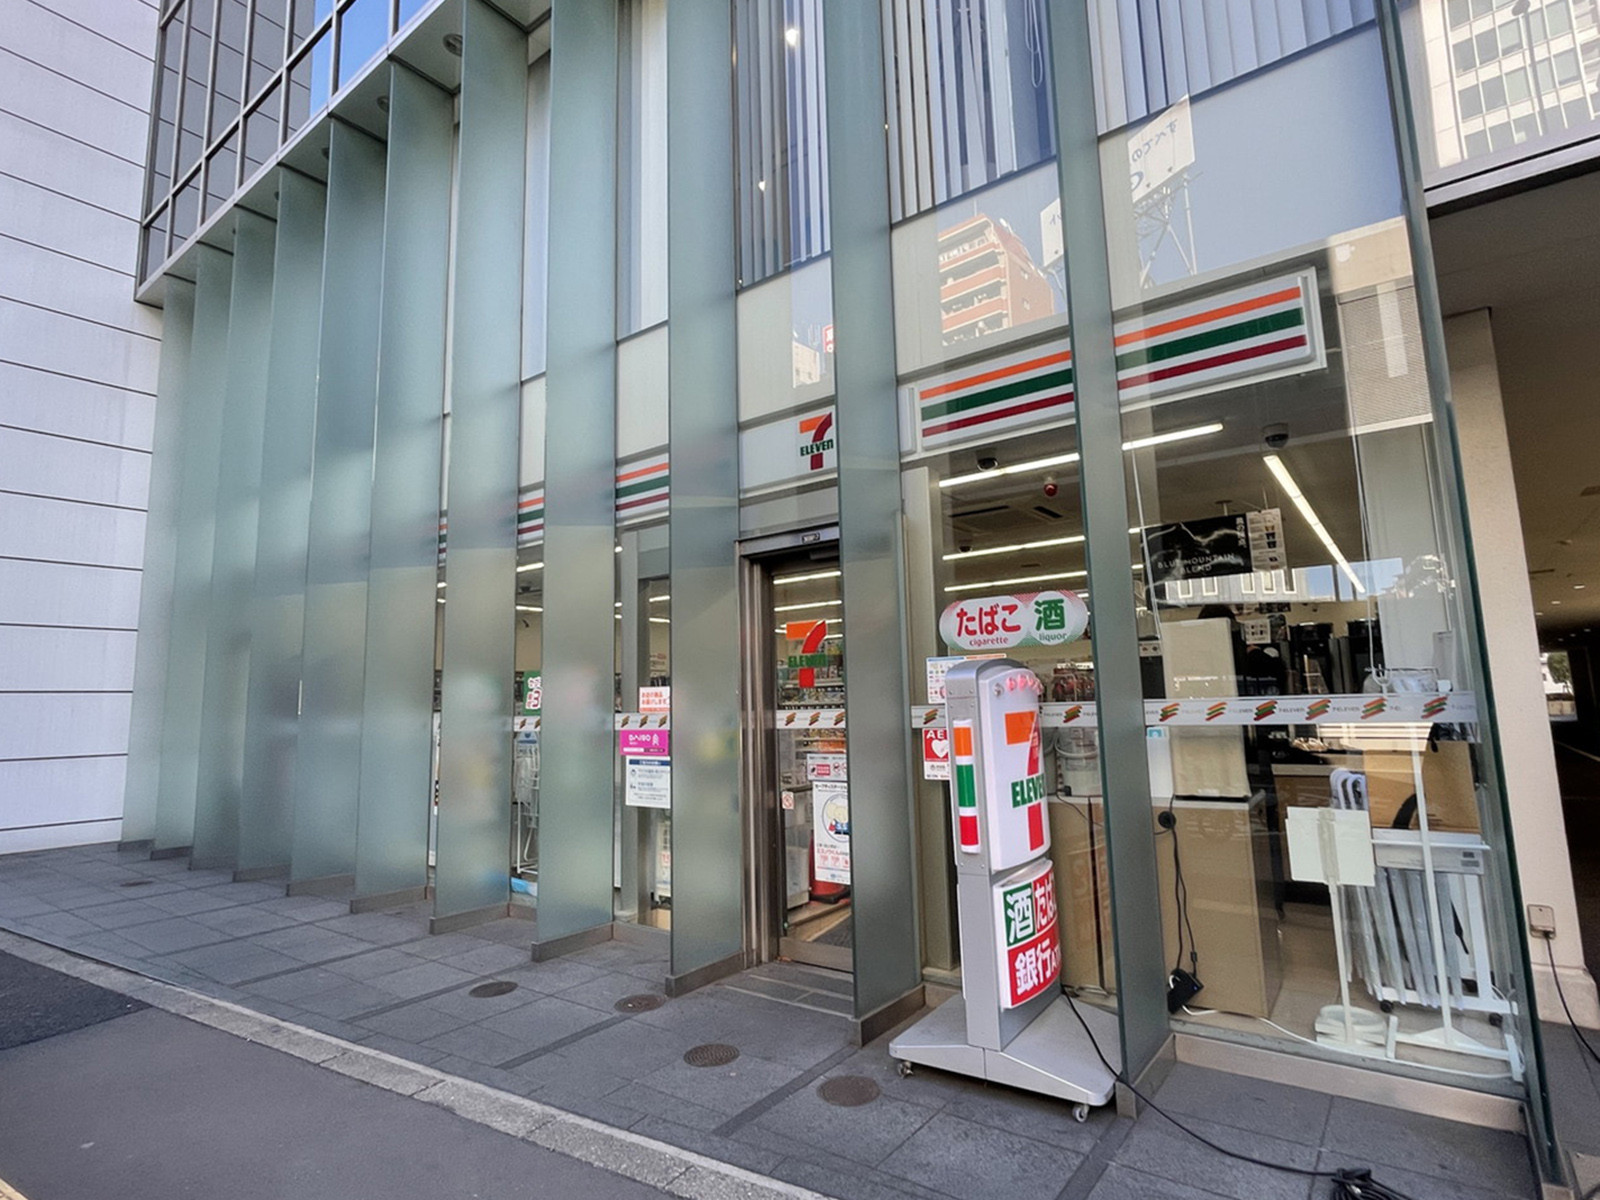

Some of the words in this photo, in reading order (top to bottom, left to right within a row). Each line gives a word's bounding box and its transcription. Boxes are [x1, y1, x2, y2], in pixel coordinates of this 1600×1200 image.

[956, 602, 1022, 638] たばこ
[1034, 598, 1066, 633] 酒
[968, 636, 1009, 648] cigarette
[1038, 632, 1068, 643] liquor
[926, 729, 946, 740] AE
[1006, 887, 1034, 943] 酒
[1034, 873, 1057, 929] たば
